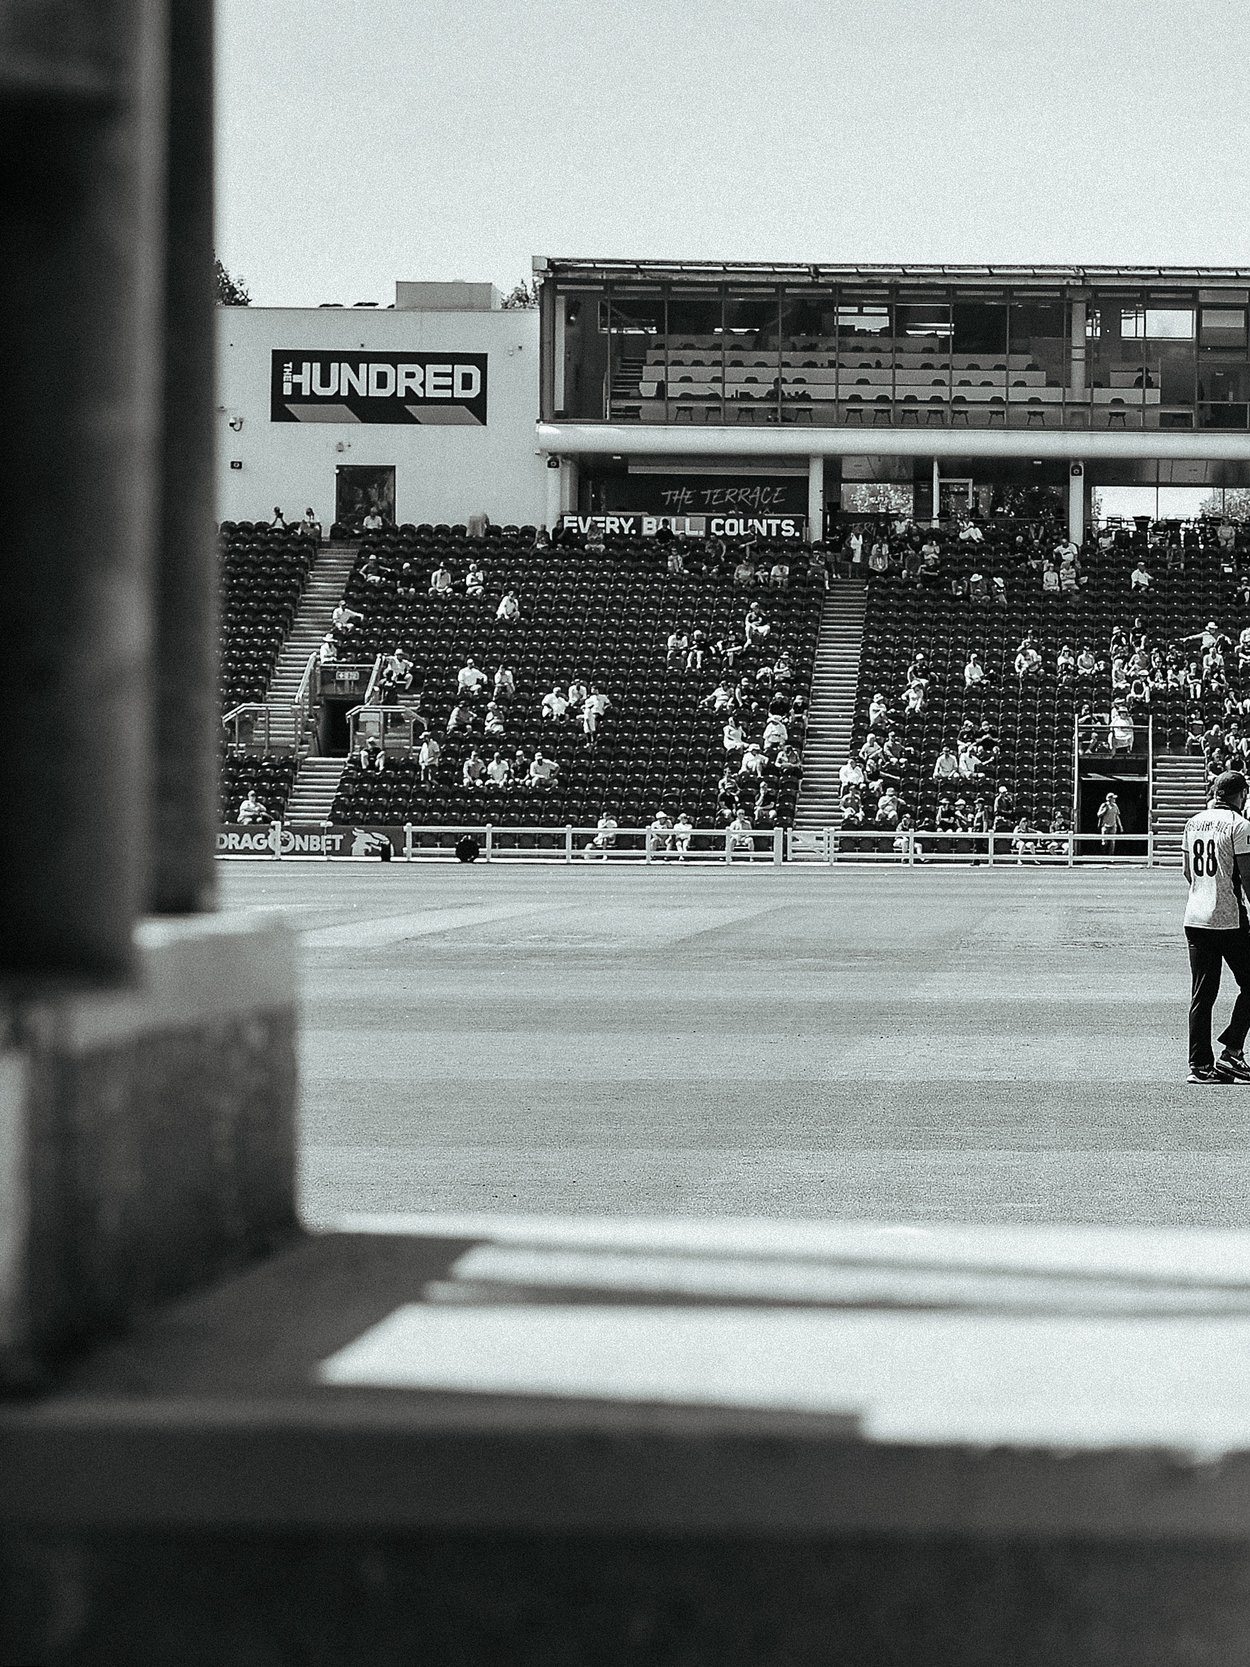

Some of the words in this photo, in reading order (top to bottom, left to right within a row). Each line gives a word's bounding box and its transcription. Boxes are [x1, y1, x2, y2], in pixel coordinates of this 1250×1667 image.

[283, 362, 292, 382] THE
[283, 362, 481, 398] HUNDRED
[661, 487, 696, 513] THE
[701, 486, 787, 509] TERRACE
[711, 518, 800, 537] COUNTS.
[1193, 839, 1218, 877] 88
